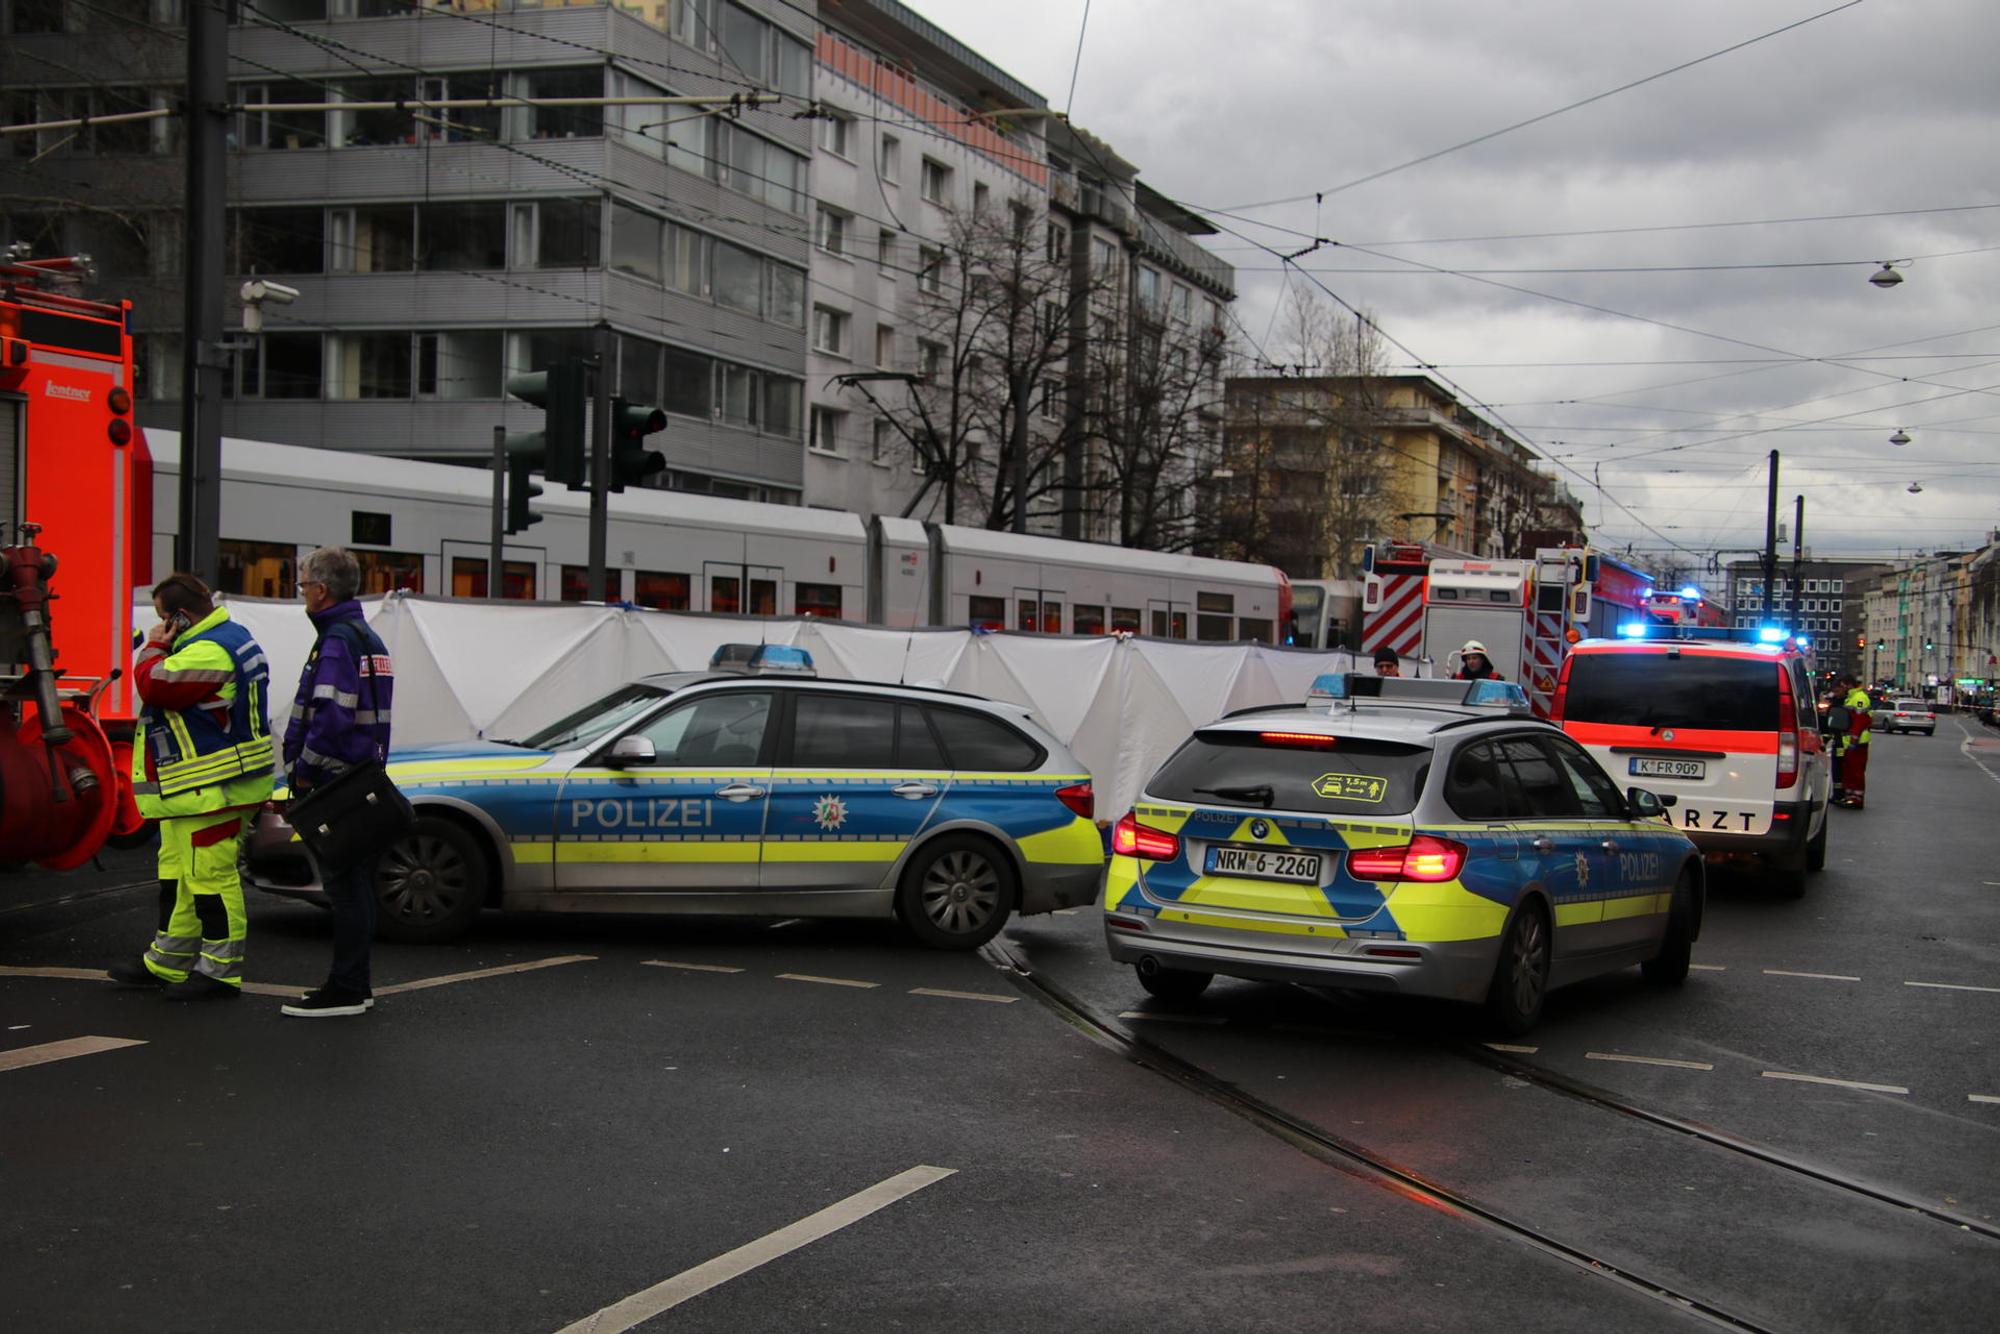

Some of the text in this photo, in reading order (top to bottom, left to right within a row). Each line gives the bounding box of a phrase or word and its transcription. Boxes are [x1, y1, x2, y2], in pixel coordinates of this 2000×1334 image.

[1641, 761, 1698, 775] K FR 909
[572, 799, 712, 828] POLIZEI
[1194, 812, 1238, 825] POLIZEI
[1215, 849, 1317, 878] NRW 6-2260
[1620, 852, 1664, 882] POLIZEI
